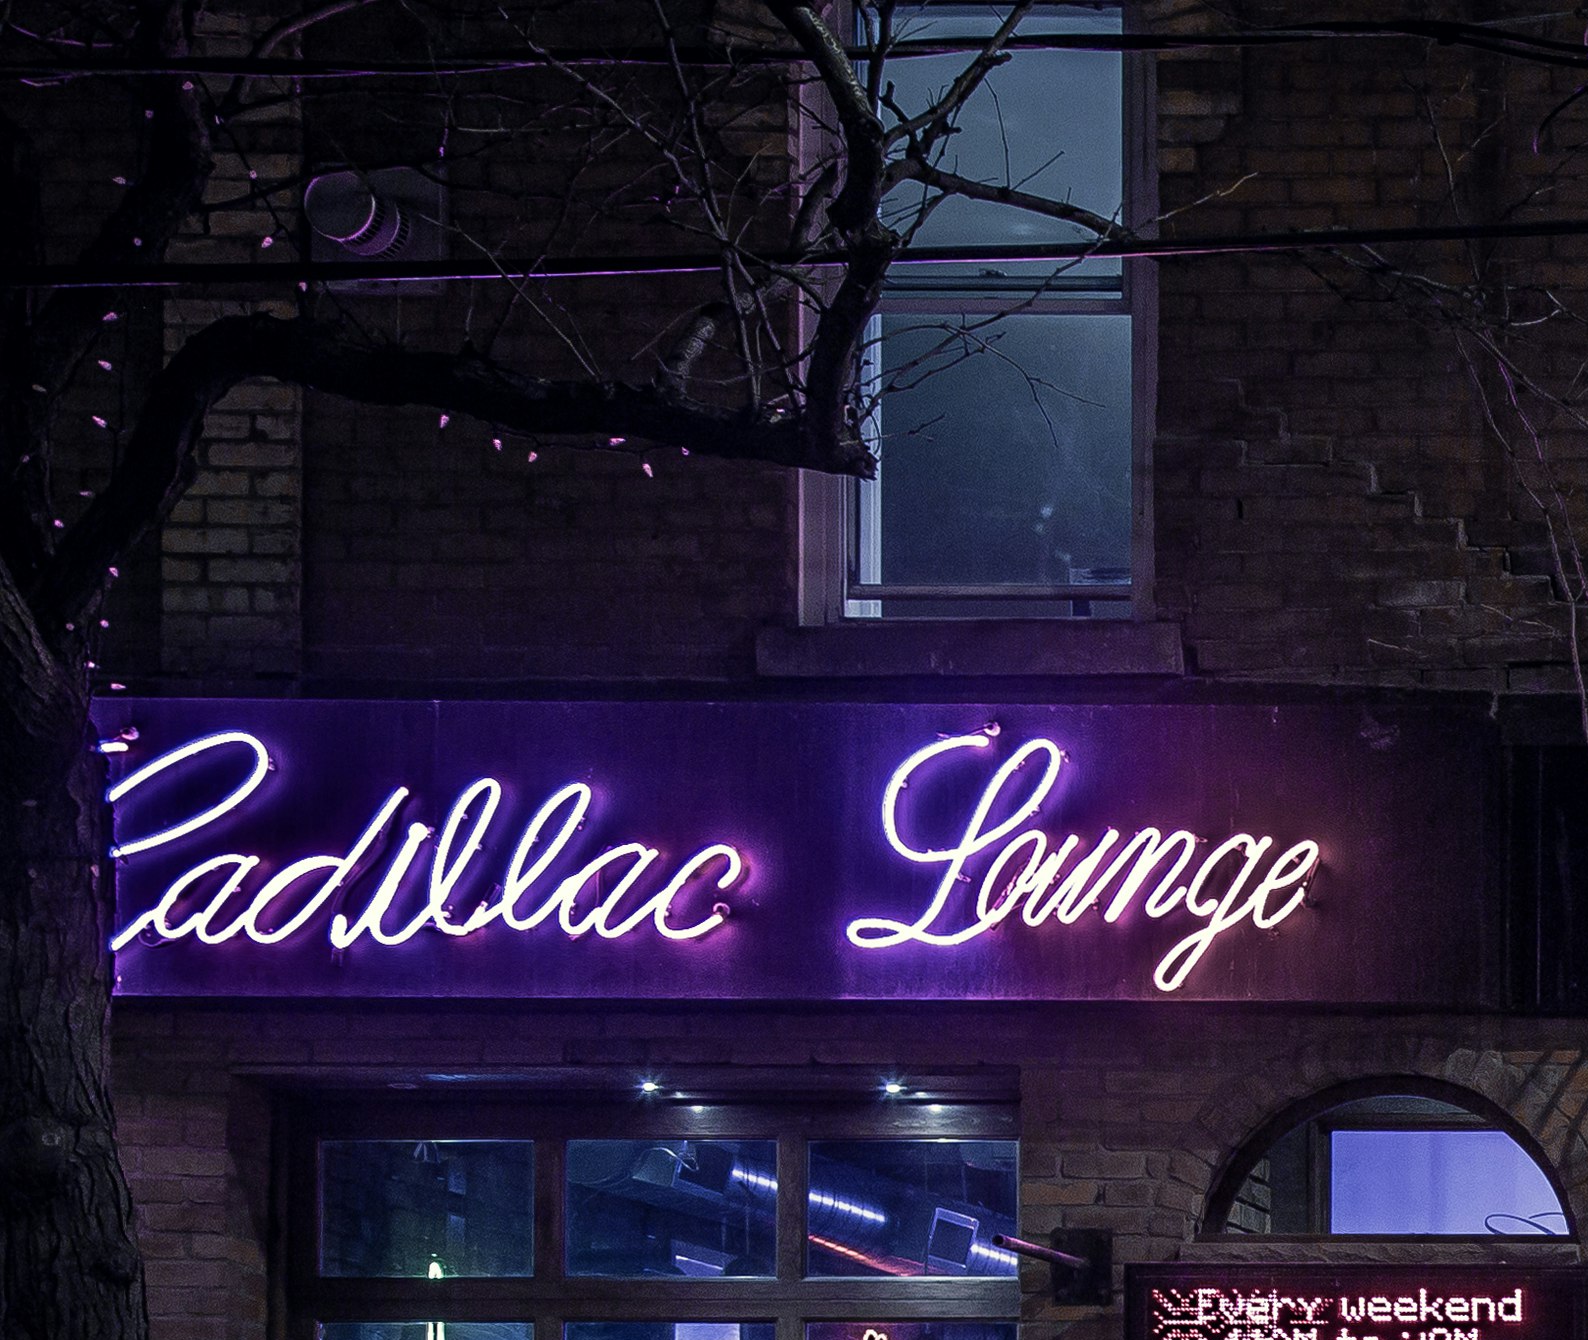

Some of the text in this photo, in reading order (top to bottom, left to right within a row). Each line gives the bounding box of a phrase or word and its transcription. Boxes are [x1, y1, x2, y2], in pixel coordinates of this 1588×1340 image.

[847, 736, 1323, 992] Lounge
[1197, 1288, 1523, 1323] Every weekend
